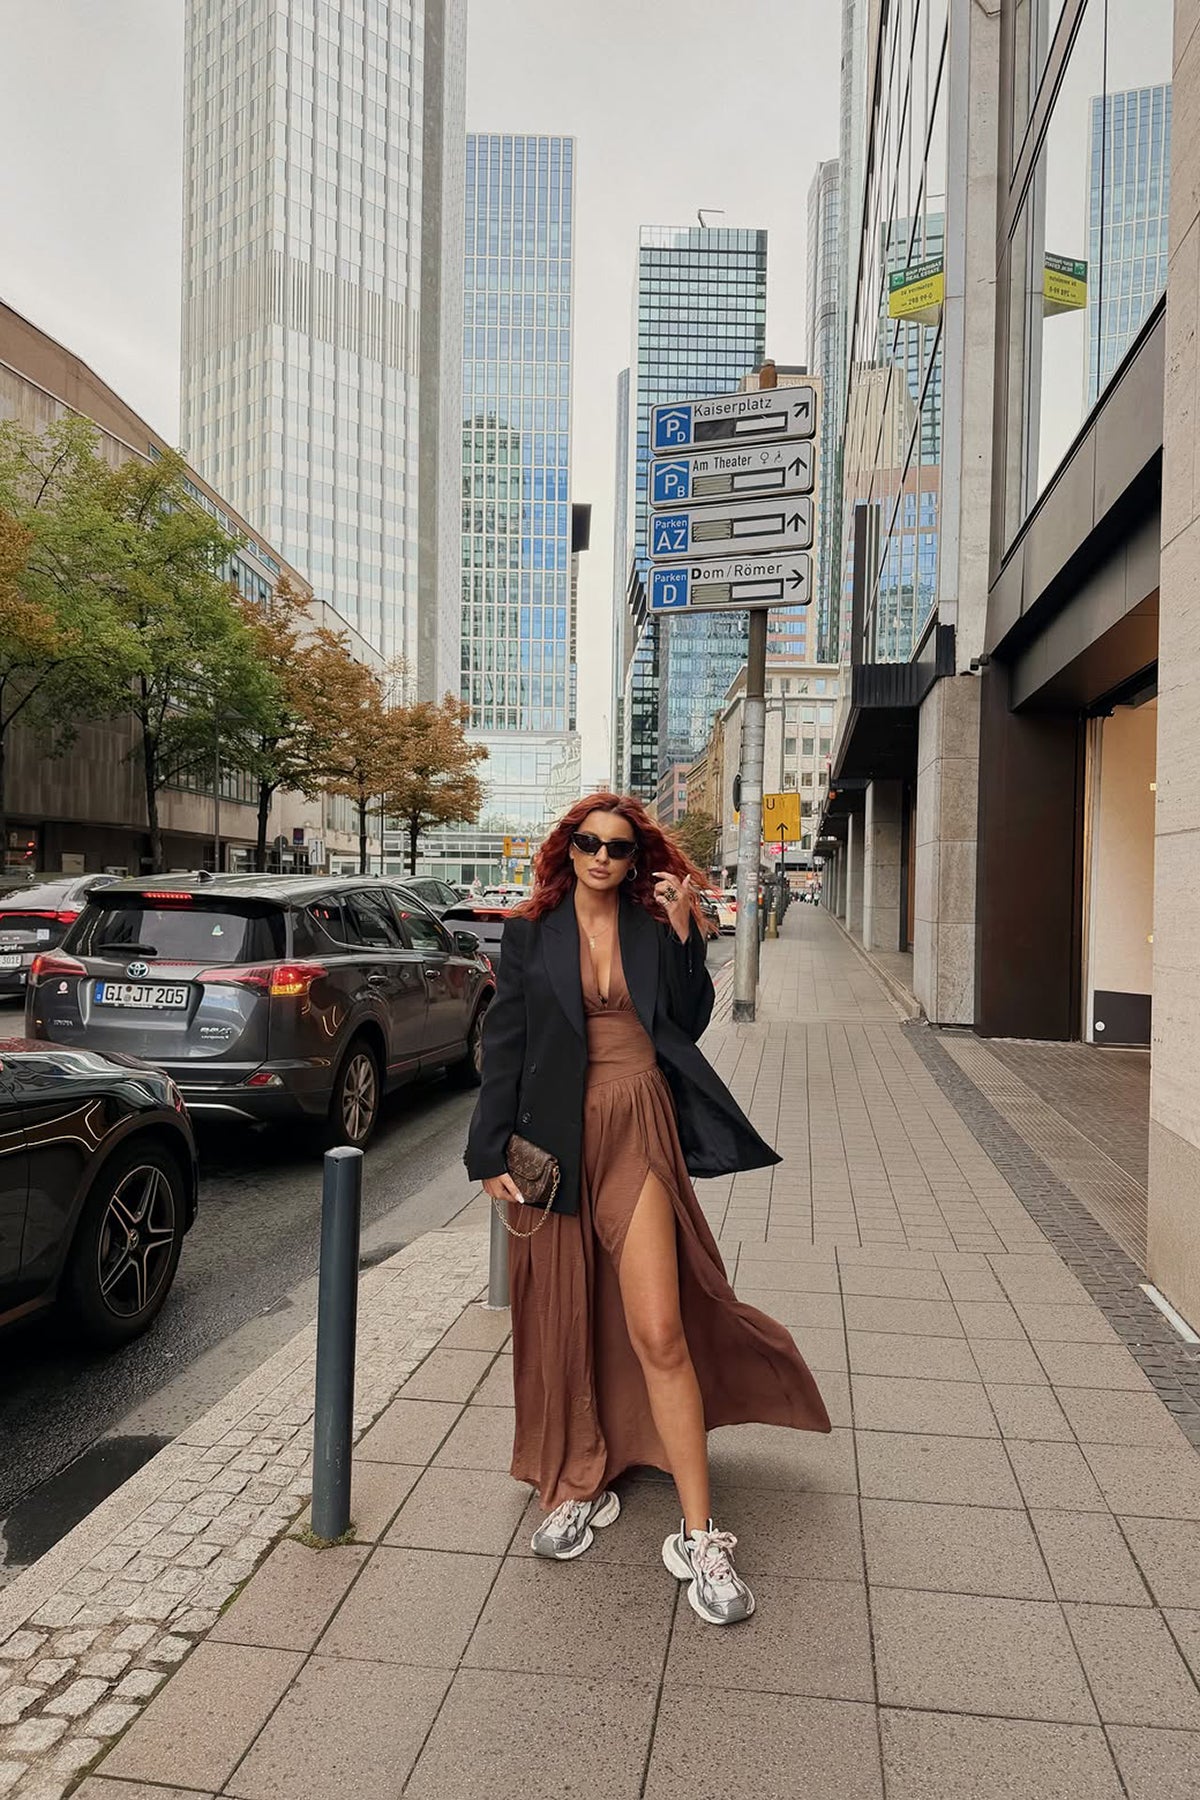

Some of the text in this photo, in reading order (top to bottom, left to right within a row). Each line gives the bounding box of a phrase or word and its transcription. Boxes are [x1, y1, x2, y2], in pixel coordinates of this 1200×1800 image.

[694, 398, 772, 417] Kaiserplatz
[693, 456, 752, 472] Am Theater
[655, 519, 688, 529] Parken
[656, 529, 686, 551] AZ
[654, 573, 687, 582] Parken
[663, 584, 677, 604] D
[766, 798, 775, 810] U
[105, 986, 184, 1004] GI JT 205
